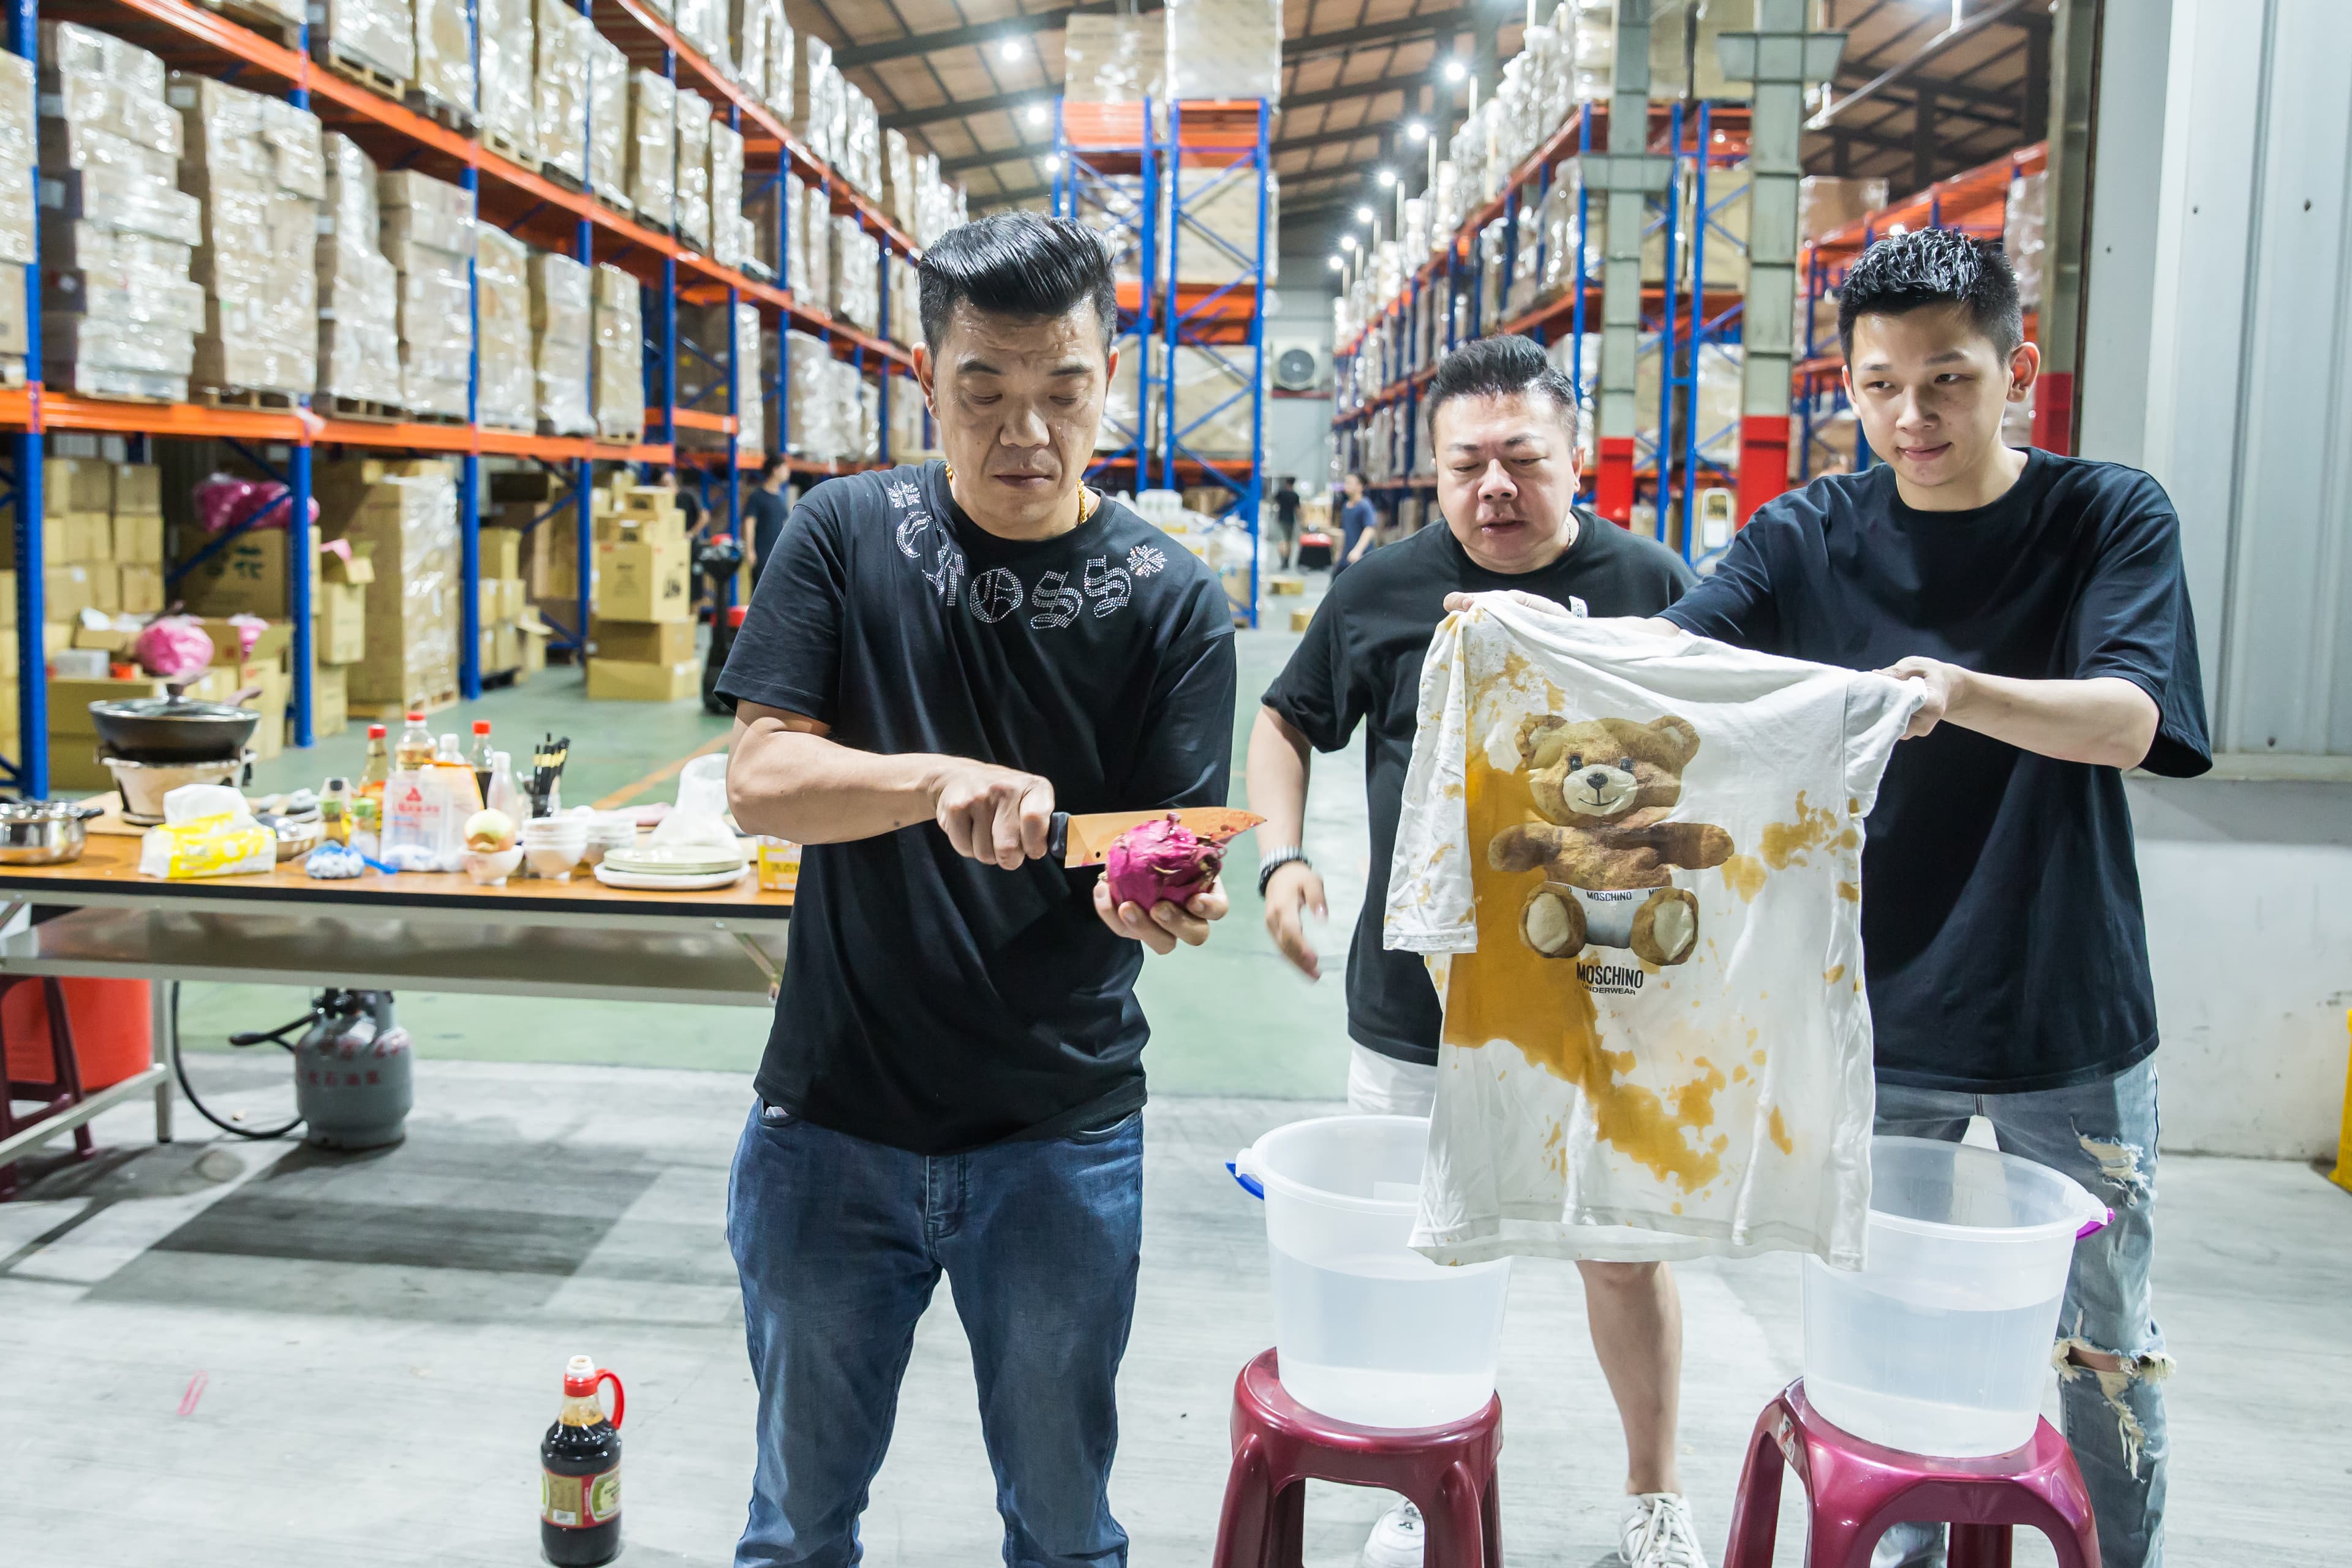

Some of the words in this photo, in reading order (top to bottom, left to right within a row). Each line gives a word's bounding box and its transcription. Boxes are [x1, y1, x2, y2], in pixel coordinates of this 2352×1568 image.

[1586, 891, 1632, 902] MOSCHINO
[1576, 962, 1644, 989] MOSCHINO
[1581, 982, 1636, 995] UNDERWEAR
